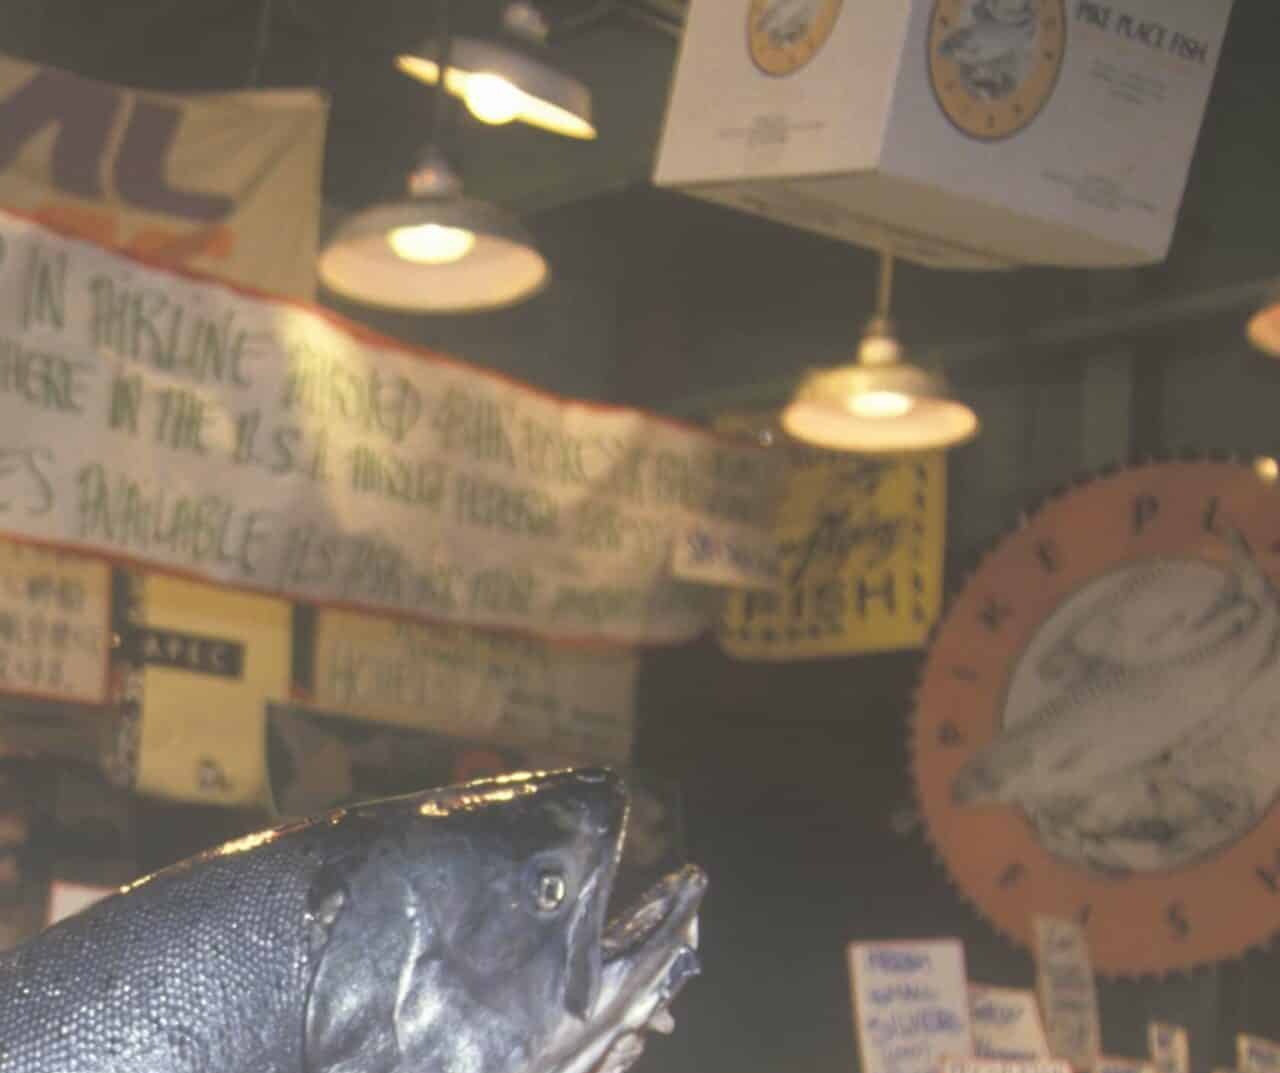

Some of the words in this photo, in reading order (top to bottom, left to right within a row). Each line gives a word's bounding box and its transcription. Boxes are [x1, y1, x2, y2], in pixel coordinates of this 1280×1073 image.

[22, 240, 68, 332] IN
[88, 273, 272, 386] AIRLINE
[106, 366, 144, 437] IN
[152, 378, 214, 456] THE
